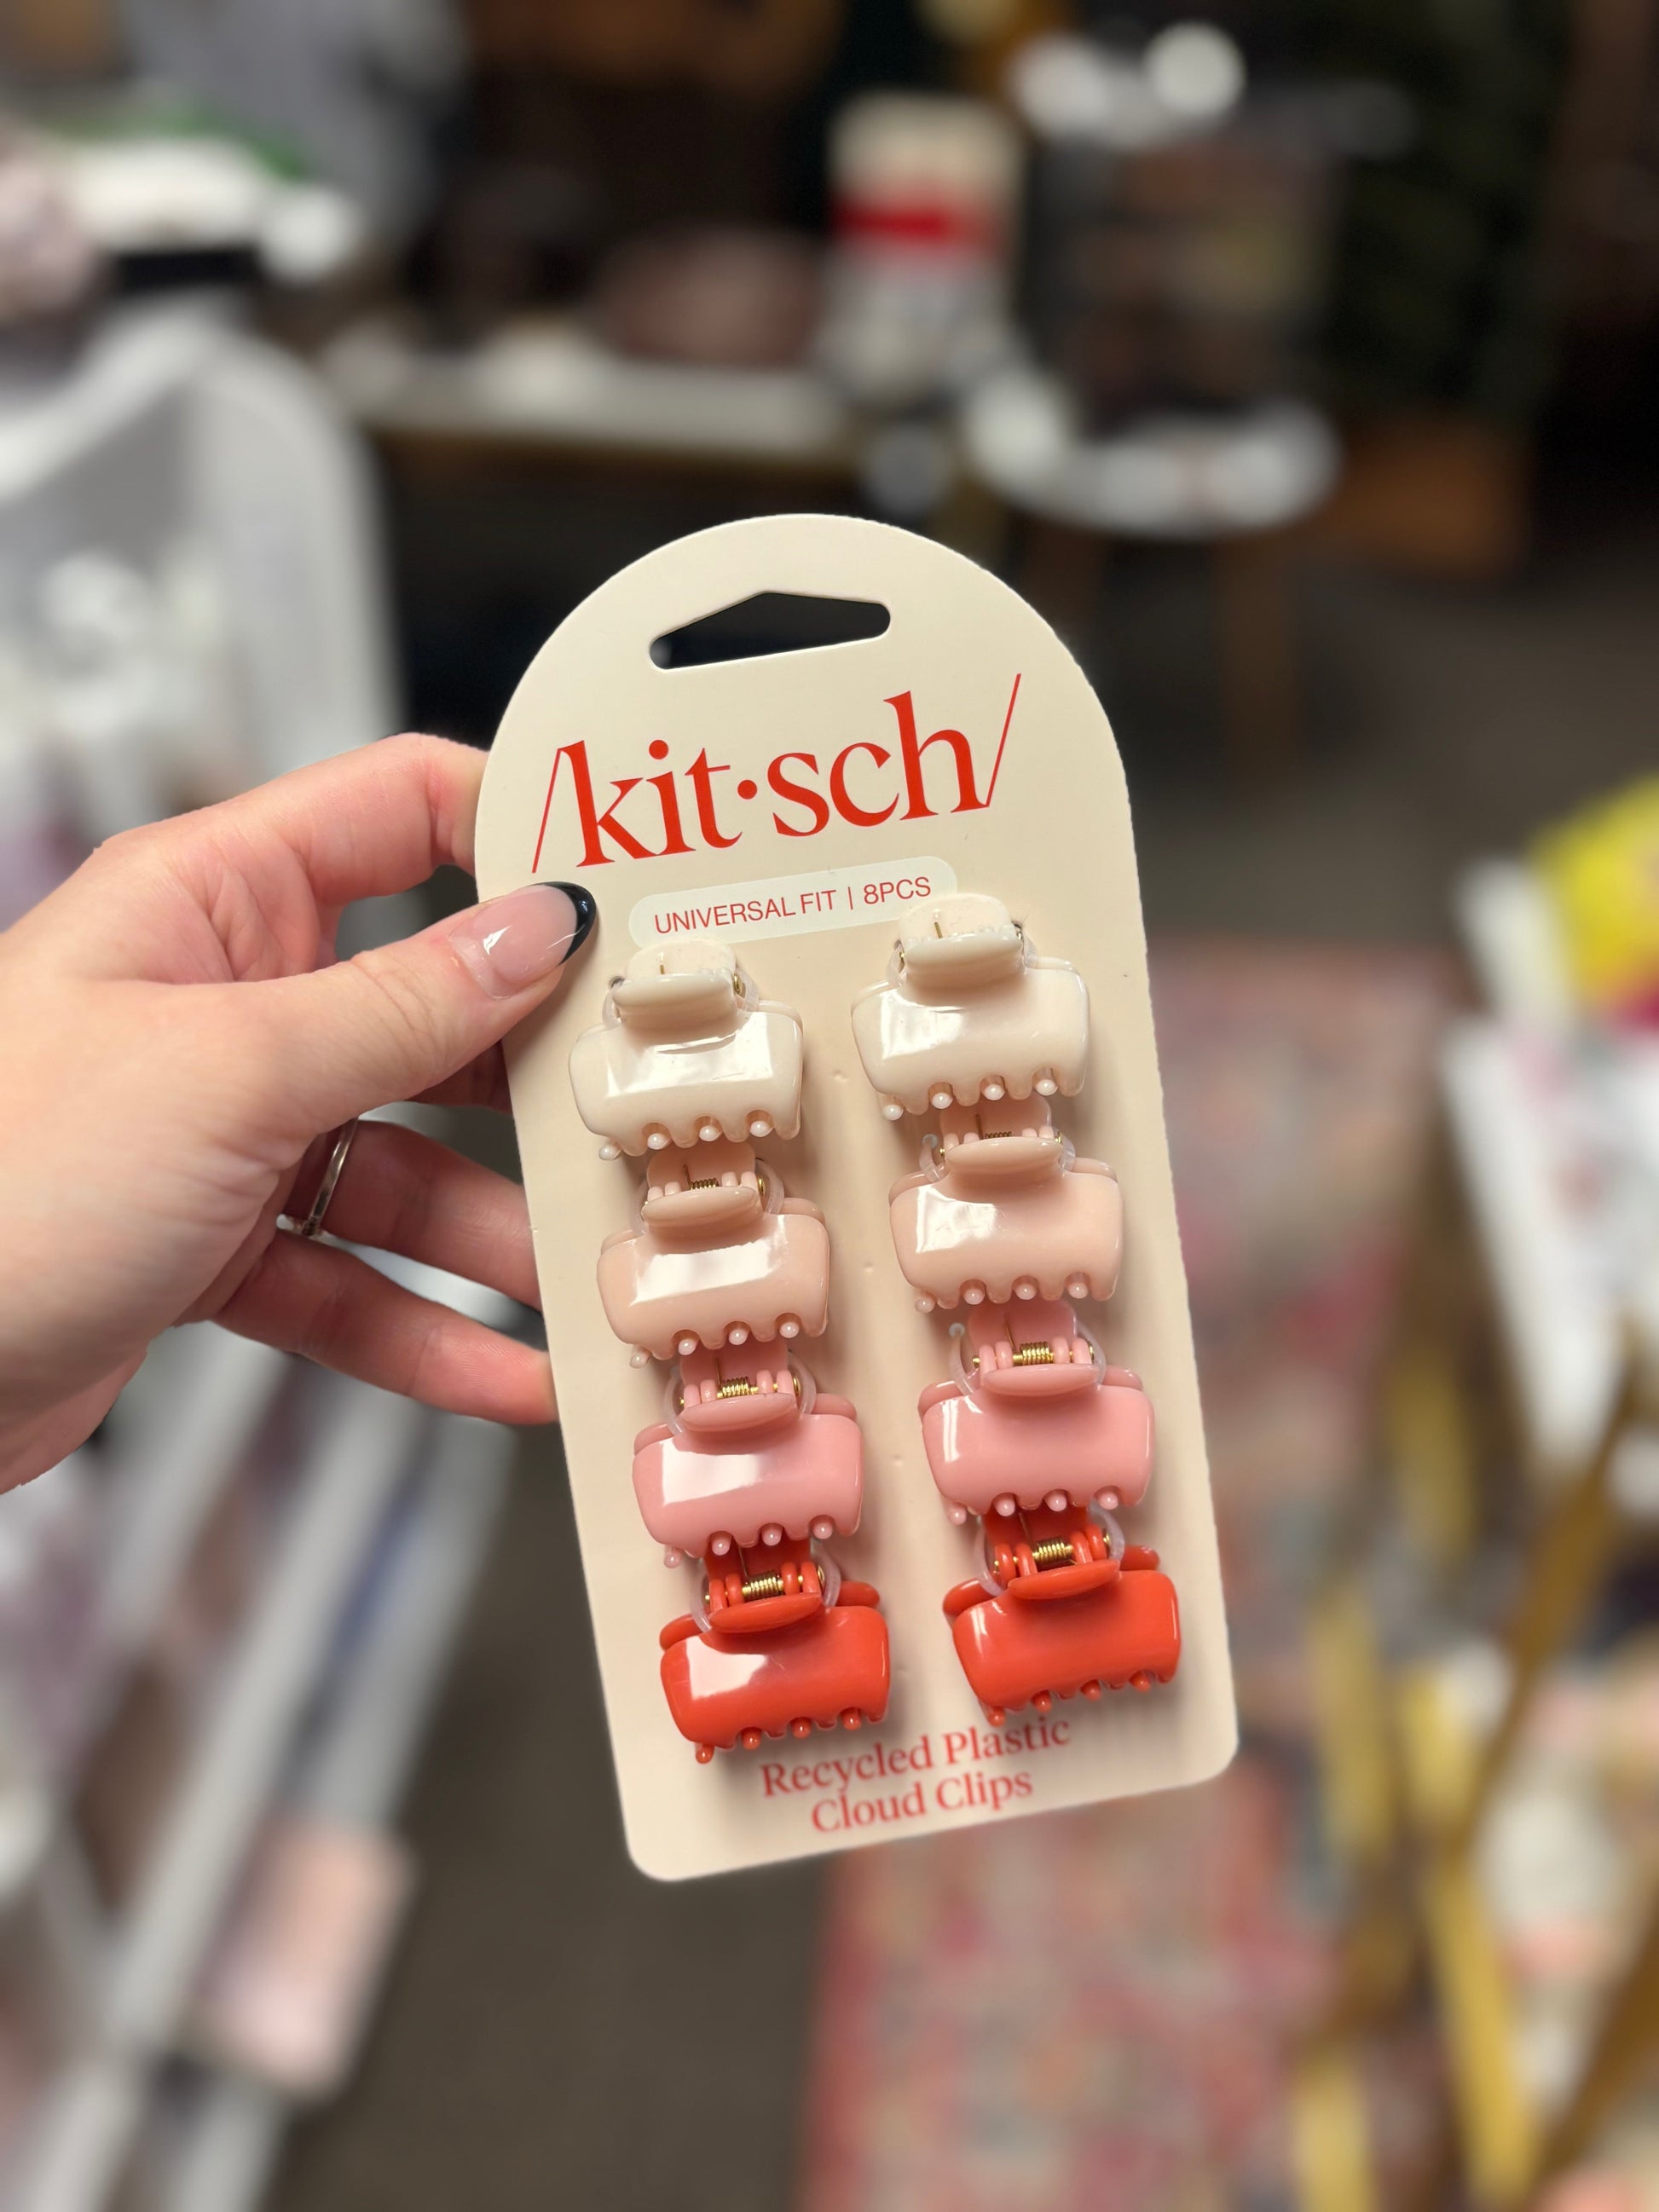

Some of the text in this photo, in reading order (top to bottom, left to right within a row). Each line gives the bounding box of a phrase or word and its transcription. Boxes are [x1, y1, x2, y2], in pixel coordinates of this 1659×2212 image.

[654, 897, 796, 934] UNIVERSAL
[801, 889, 837, 914] FIT
[863, 875, 932, 905] 8PCS
[760, 1717, 1071, 1798] Recycled Plastic
[811, 1769, 1033, 1833] Cloud Clips
